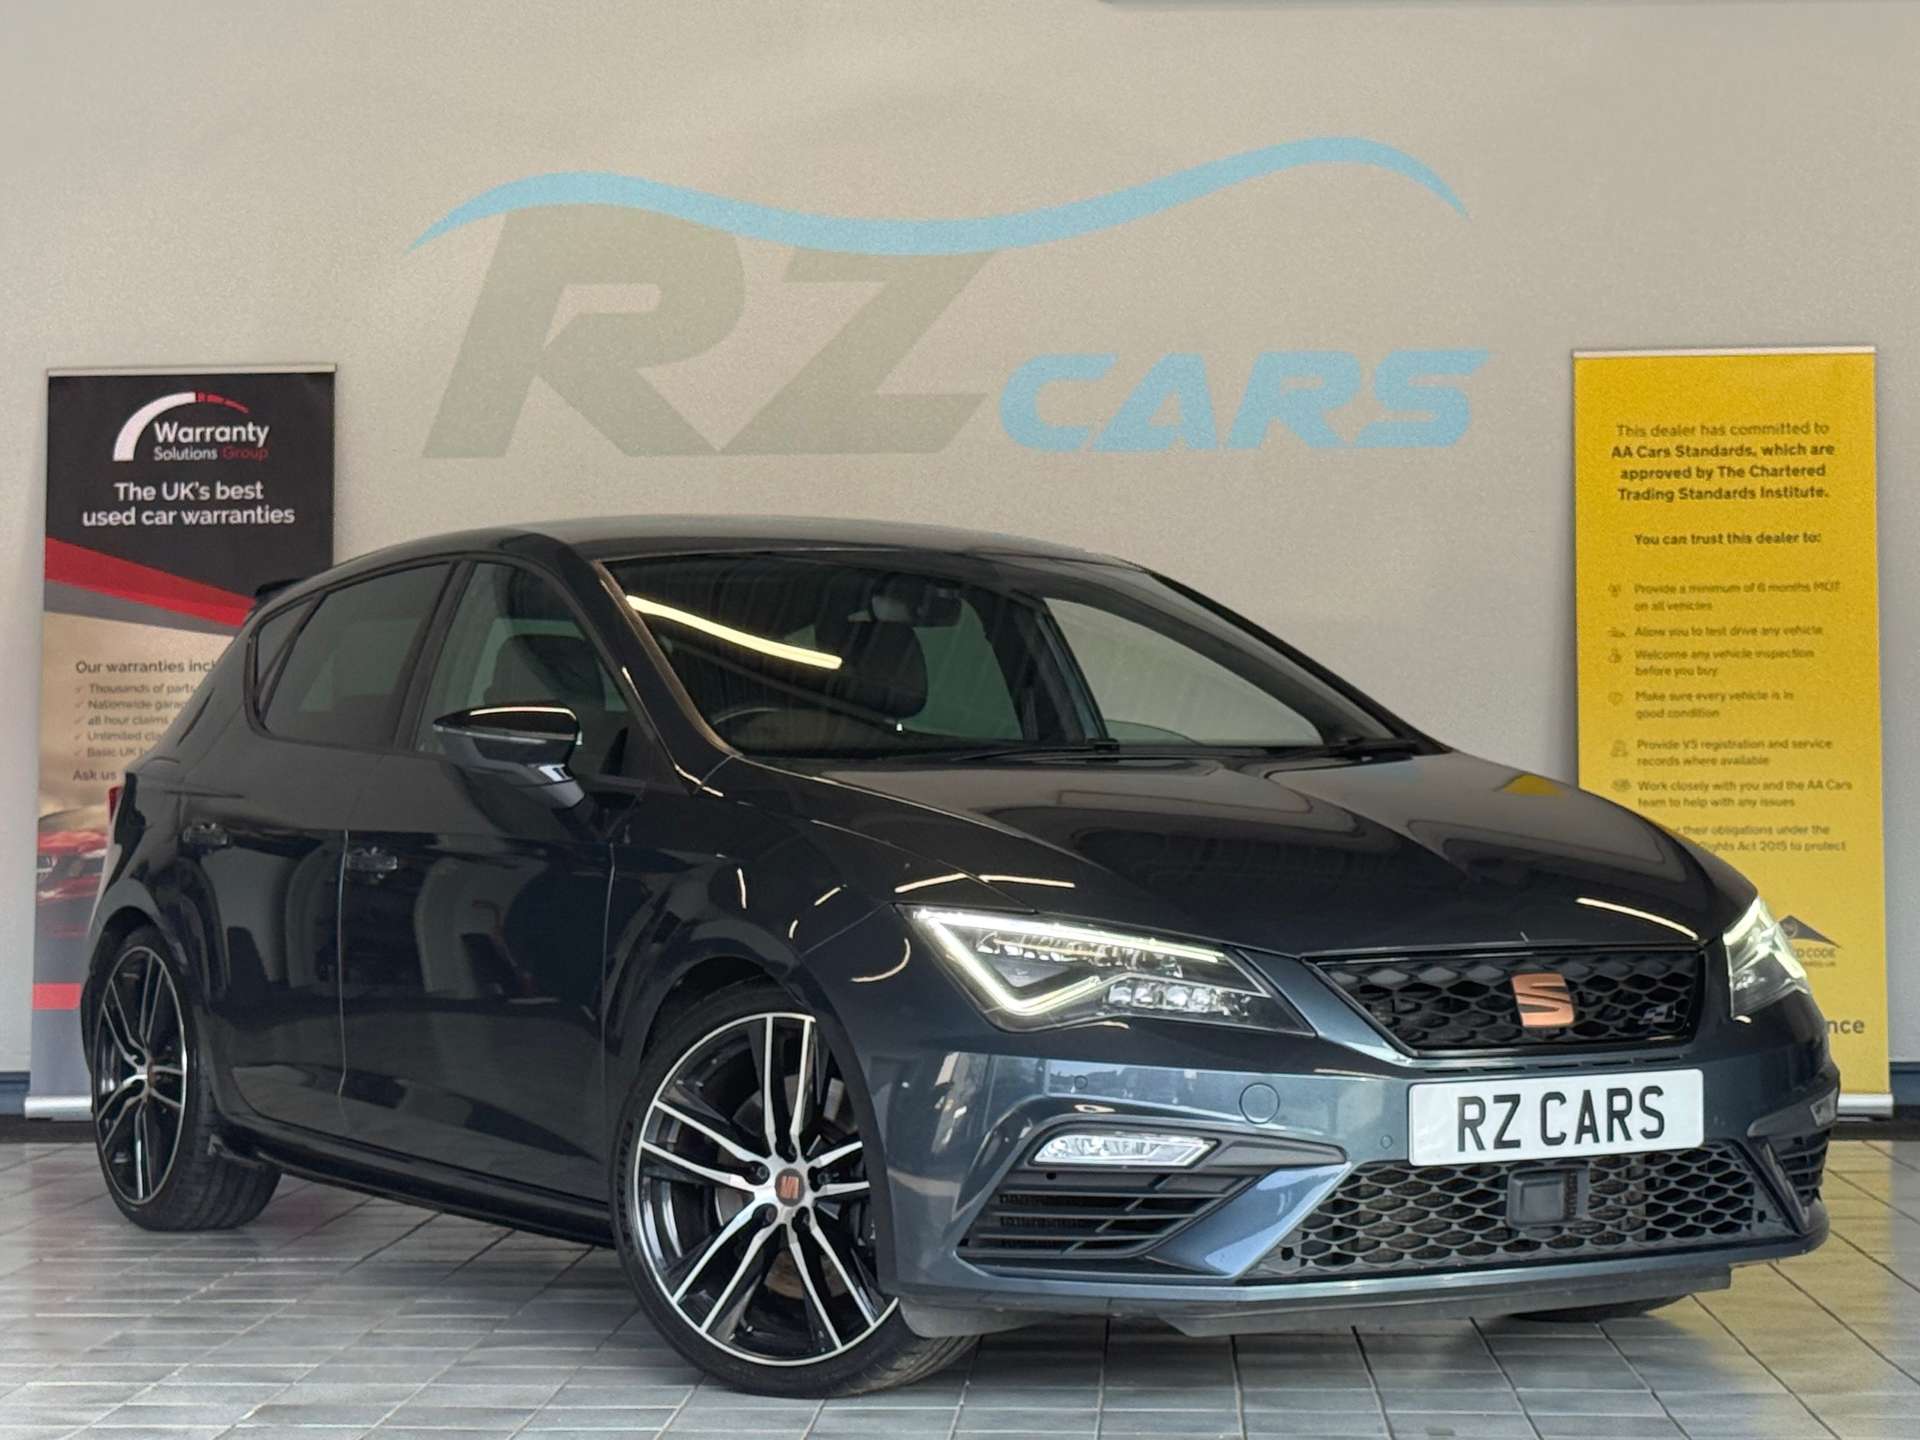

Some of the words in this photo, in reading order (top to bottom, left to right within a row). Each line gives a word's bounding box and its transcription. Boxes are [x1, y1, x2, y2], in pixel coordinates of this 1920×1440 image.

[421, 203, 998, 458] RZ
[1000, 348, 1488, 453] CARS
[154, 421, 269, 448] Warranty
[1616, 424, 1647, 438] This
[1651, 424, 1695, 437] dealer
[1701, 424, 1725, 436] has
[1730, 422, 1810, 436] committed
[1814, 422, 1829, 435] to
[154, 446, 218, 461] Solutions
[222, 446, 269, 461] Group
[1612, 446, 1633, 458] AA
[1637, 445, 1671, 458] Cars
[1675, 444, 1757, 458] Standards,
[1761, 443, 1807, 456] which
[1810, 445, 1835, 456] are
[1620, 466, 1692, 481] approved
[1696, 466, 1713, 481] by
[1718, 466, 1745, 478] The
[1750, 464, 1826, 478] Chartered
[114, 482, 156, 501] The
[162, 481, 210, 501] UK's
[216, 481, 264, 500] best
[1618, 488, 1674, 502] Trading
[1678, 487, 1756, 500] Standards
[1761, 486, 1829, 499] Institute.
[82, 506, 136, 526] used
[141, 510, 177, 525] car
[181, 505, 295, 525] warranties
[1635, 534, 1660, 545] You
[1662, 535, 1687, 545] can
[1691, 532, 1723, 544] trust
[1727, 532, 1752, 544] this
[1756, 532, 1799, 544] dealer
[1803, 531, 1821, 543] to:
[1634, 584, 1677, 593] Provide
[1688, 585, 1741, 593] minimum
[1743, 582, 1755, 592] of
[1757, 582, 1766, 592] 6
[1767, 583, 1811, 592] months
[1813, 581, 1840, 592] MOT
[1634, 603, 1648, 611] on
[1651, 601, 1665, 611] all
[1667, 601, 1712, 611] vehicles
[1634, 627, 1665, 637] Allow
[1668, 628, 1689, 638] you
[1691, 627, 1703, 636] to
[1705, 626, 1727, 636] test
[1729, 625, 1757, 636] drive
[1760, 627, 1779, 637] any
[1782, 625, 1823, 635] vehicle
[1634, 650, 1688, 660] Welcome
[1691, 651, 1710, 661] any
[1712, 648, 1753, 659] vehicle
[1755, 648, 1815, 660] inspection
[75, 661, 103, 674] Our
[106, 660, 185, 673] warranties
[1635, 666, 1672, 676] before
[1673, 668, 1695, 678] you
[1697, 666, 1718, 677] buy
[89, 683, 150, 694] Thousands
[153, 683, 165, 693] of
[1635, 691, 1666, 701] Make
[1668, 693, 1692, 701] sure
[1695, 693, 1726, 702] every
[1728, 691, 1768, 701] vehicle
[1771, 691, 1779, 700] is
[1783, 690, 1794, 700] in
[88, 700, 153, 710] Nationwide
[1635, 708, 1665, 719] good
[1667, 707, 1720, 718] condition
[104, 715, 130, 725] hour
[132, 715, 168, 725] claims
[88, 731, 142, 741] Unlimited
[1637, 739, 1679, 749] Provide
[1682, 740, 1698, 749] V5
[1700, 739, 1765, 751] registration
[1767, 739, 1788, 749] and
[1791, 739, 1833, 749] service
[88, 748, 117, 758] Basic
[120, 748, 137, 757] UK
[1637, 756, 1680, 766] records
[1683, 756, 1718, 766] where
[1720, 755, 1769, 766] available
[72, 769, 97, 781] Ask
[101, 771, 117, 781] us
[1638, 781, 1667, 791] Work
[1670, 781, 1710, 792] closely
[1712, 781, 1737, 791] with
[1740, 783, 1759, 793] you
[1762, 781, 1784, 791] and
[1786, 780, 1805, 790] the
[1807, 779, 1824, 790] AA
[1825, 779, 1853, 790] Cars
[1638, 798, 1666, 807] team
[1668, 798, 1681, 807] to
[1683, 797, 1708, 808] help
[1710, 797, 1735, 807] with
[1738, 799, 1757, 808] any
[1759, 797, 1796, 807] issues
[1683, 825, 1708, 835] their
[1711, 825, 1773, 836] obligations
[1776, 825, 1808, 835] under
[1810, 824, 1830, 835] the
[1737, 841, 1757, 851] Act
[1760, 841, 1788, 852] 2015
[1789, 841, 1802, 851] to
[1804, 841, 1847, 852] protect
[1827, 1019, 1865, 1034] nce
[1458, 1093, 1521, 1152] RZ
[1540, 1085, 1666, 1147] CARS
